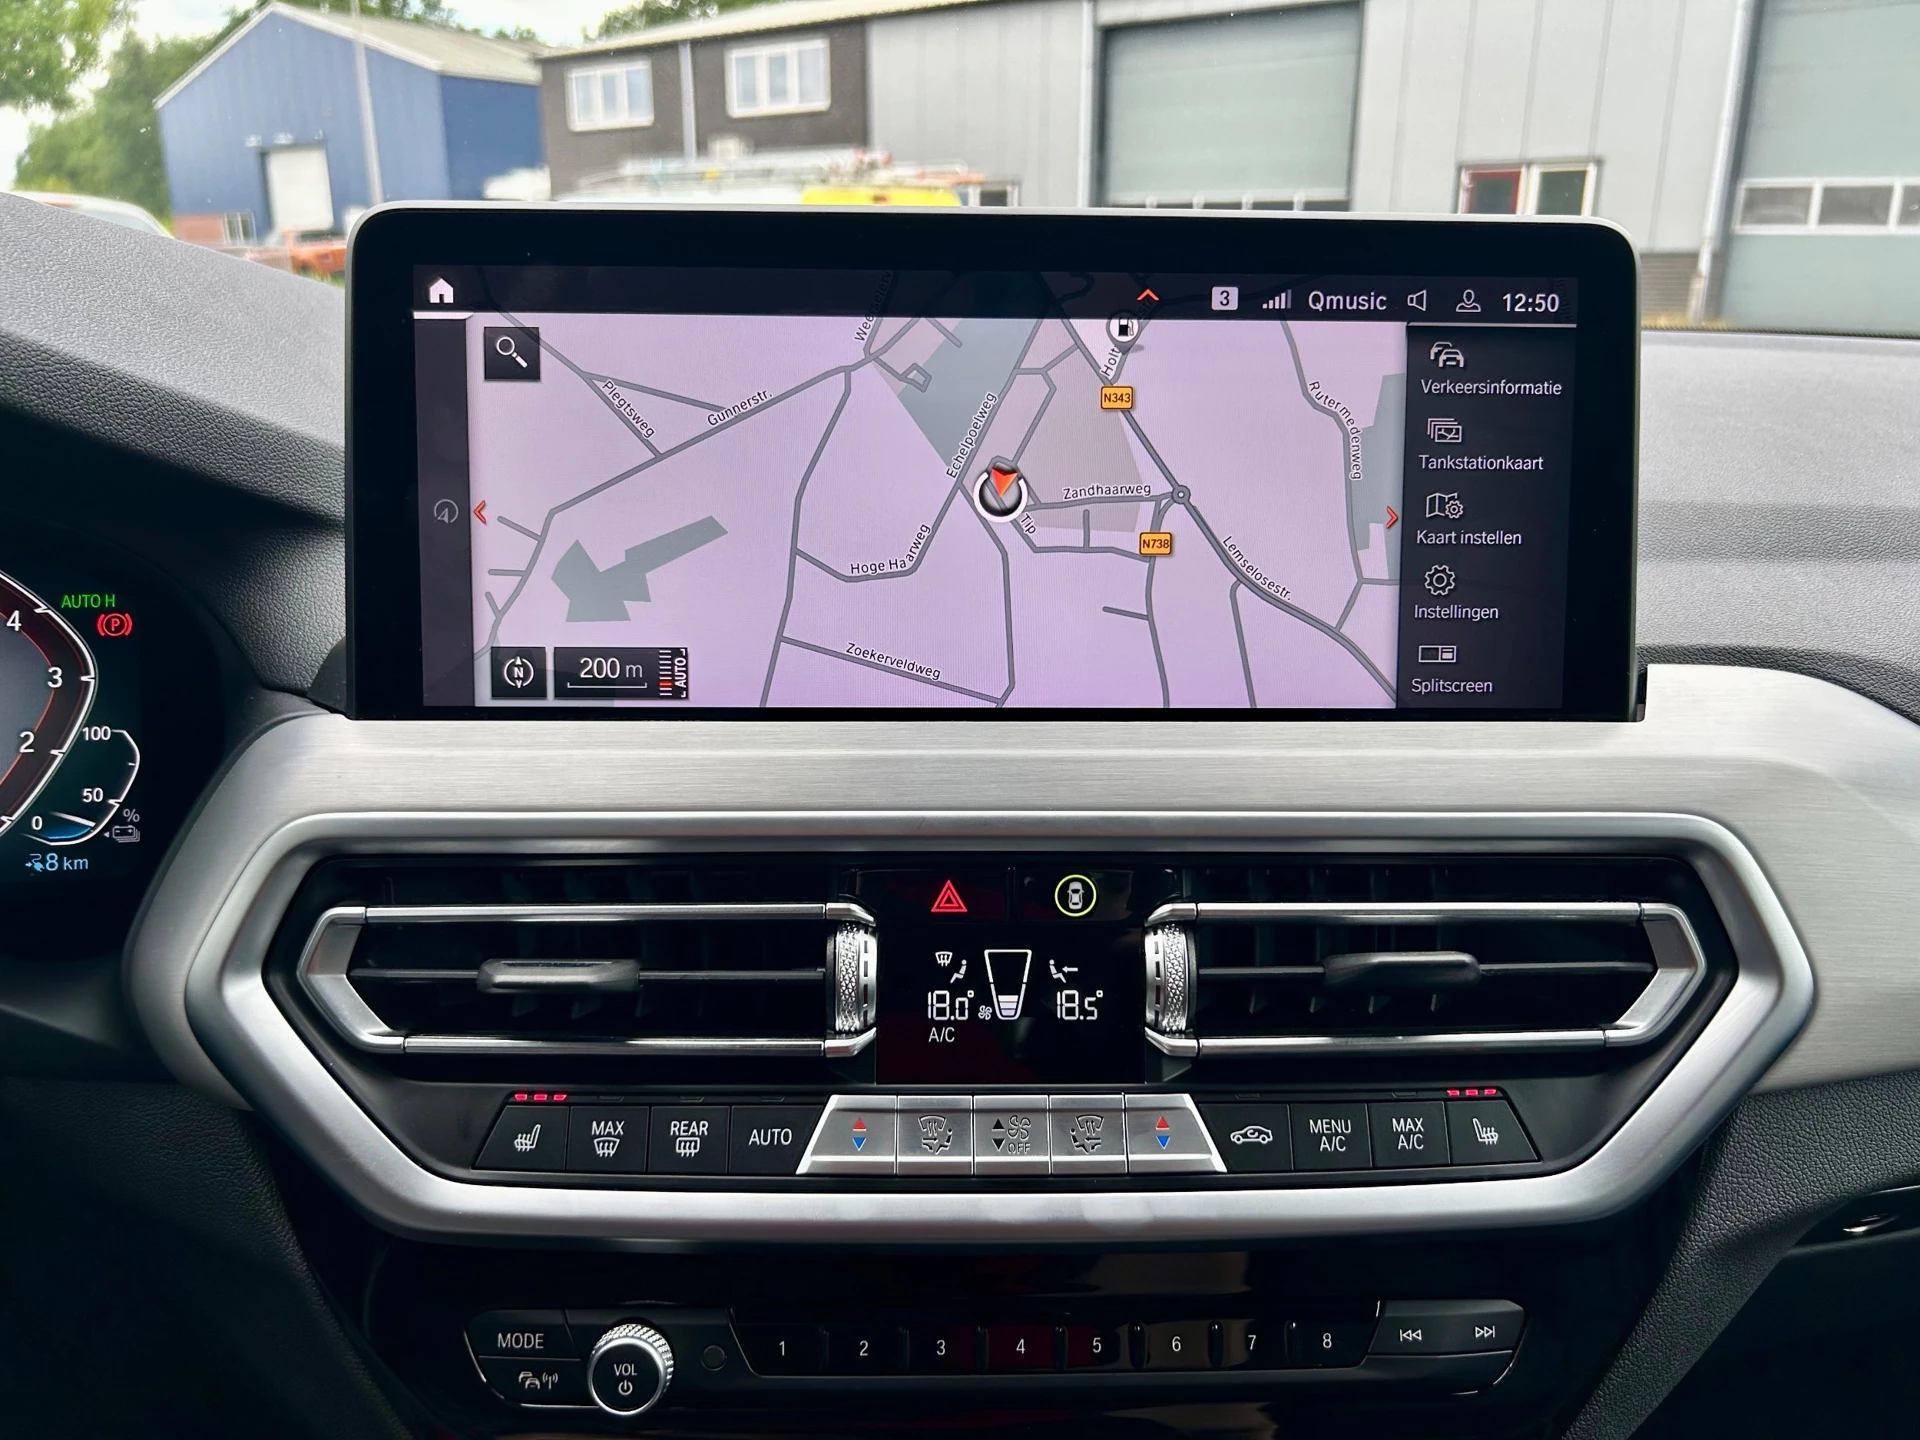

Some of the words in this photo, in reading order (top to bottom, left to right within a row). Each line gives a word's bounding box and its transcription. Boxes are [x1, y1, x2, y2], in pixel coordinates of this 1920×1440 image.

[1219, 290, 1230, 307] 3
[1308, 290, 1387, 312] Qmusic
[1502, 293, 1560, 313] 12:50
[1420, 379, 1563, 396] Verkeersinformatie
[1103, 392, 1131, 405] N343
[602, 381, 656, 439] Plegtsweg
[707, 390, 774, 427] Gunnerstr.
[946, 392, 998, 479] Echelpoelweg
[1309, 381, 1361, 480] Rutermedenweg
[1418, 454, 1544, 470] Tankstationkaart
[1063, 483, 1152, 500] Zandhaarweg
[1020, 513, 1037, 535] Tip
[1142, 537, 1170, 551] N738
[1416, 529, 1457, 546] Kaart
[1460, 529, 1522, 546] instellen
[850, 559, 886, 576] Hoge
[1222, 535, 1293, 601] Lemselosestr.
[61, 593, 102, 609] AUTO
[104, 593, 116, 608] H
[6, 610, 22, 632] 4
[1414, 604, 1499, 622] Instellingen
[111, 617, 121, 632] P
[579, 657, 621, 679] 200
[625, 664, 643, 678] m
[846, 642, 941, 680] Zoekerveldweg
[47, 666, 63, 689] 3
[514, 666, 524, 679] N
[674, 657, 687, 688] AUTO
[1411, 678, 1493, 696] Splitscreen
[19, 731, 35, 753] 2
[81, 726, 112, 741] 100
[82, 787, 104, 803] 50
[31, 815, 43, 831] 0
[122, 808, 141, 823] %
[45, 853, 58, 871] 8
[63, 856, 89, 871] km
[928, 1026, 956, 1043] A/C
[591, 1120, 625, 1136] MAX
[670, 1120, 709, 1136] REAR
[1309, 1118, 1352, 1134] MENU
[1392, 1117, 1425, 1132] MAX
[748, 1128, 793, 1146] AUTO
[1319, 1135, 1347, 1152] A/C
[1397, 1134, 1425, 1150] A/C
[1007, 1142, 1031, 1155] OFF
[497, 1332, 544, 1350] MODE
[778, 1340, 786, 1356] 1
[859, 1340, 869, 1357] 2
[936, 1339, 946, 1356] 3
[1016, 1338, 1026, 1354] 4
[1092, 1337, 1102, 1353] 5
[1172, 1336, 1182, 1352] 6
[1248, 1334, 1257, 1350] 7
[1322, 1332, 1332, 1349] 8
[613, 1363, 639, 1377] VOL
